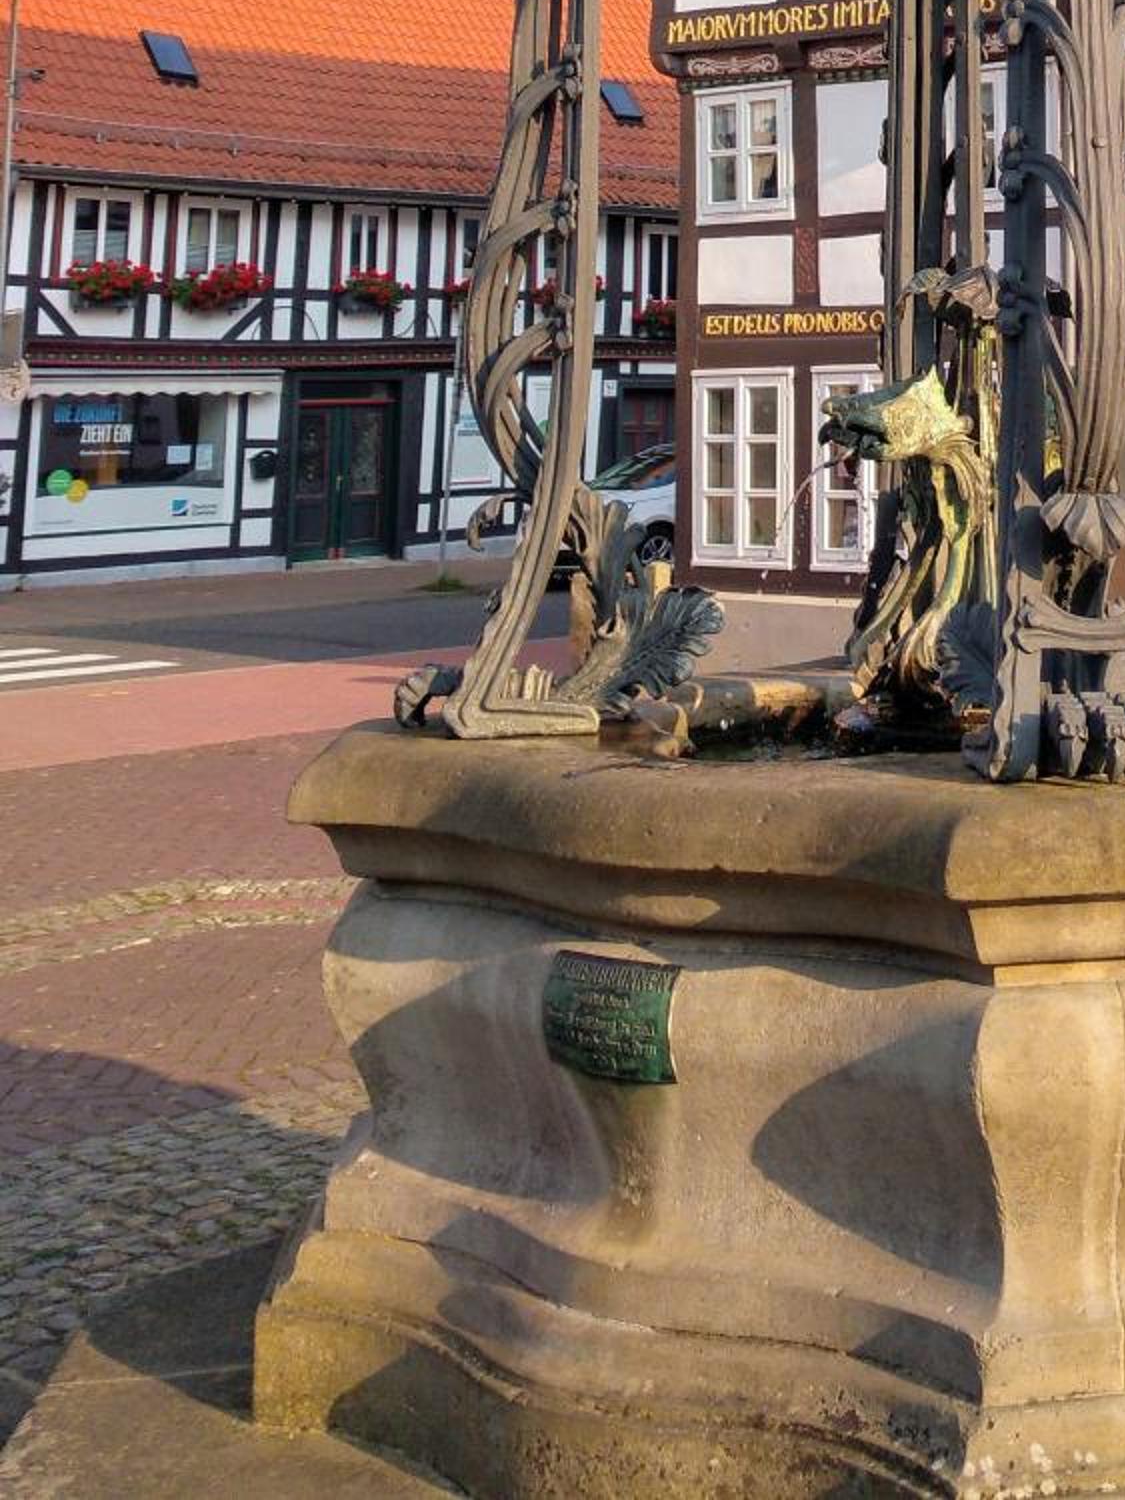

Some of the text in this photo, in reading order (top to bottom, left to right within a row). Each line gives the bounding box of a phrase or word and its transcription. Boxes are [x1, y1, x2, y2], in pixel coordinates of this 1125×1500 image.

[668, 13, 756, 44] MAIORVM
[759, 4, 828, 35] MORES
[705, 314, 729, 336] EST
[733, 313, 780, 335] DEUS
[783, 312, 815, 334] PRO
[815, 311, 867, 333] NOBIS
[80, 424, 112, 444] ZIEHT
